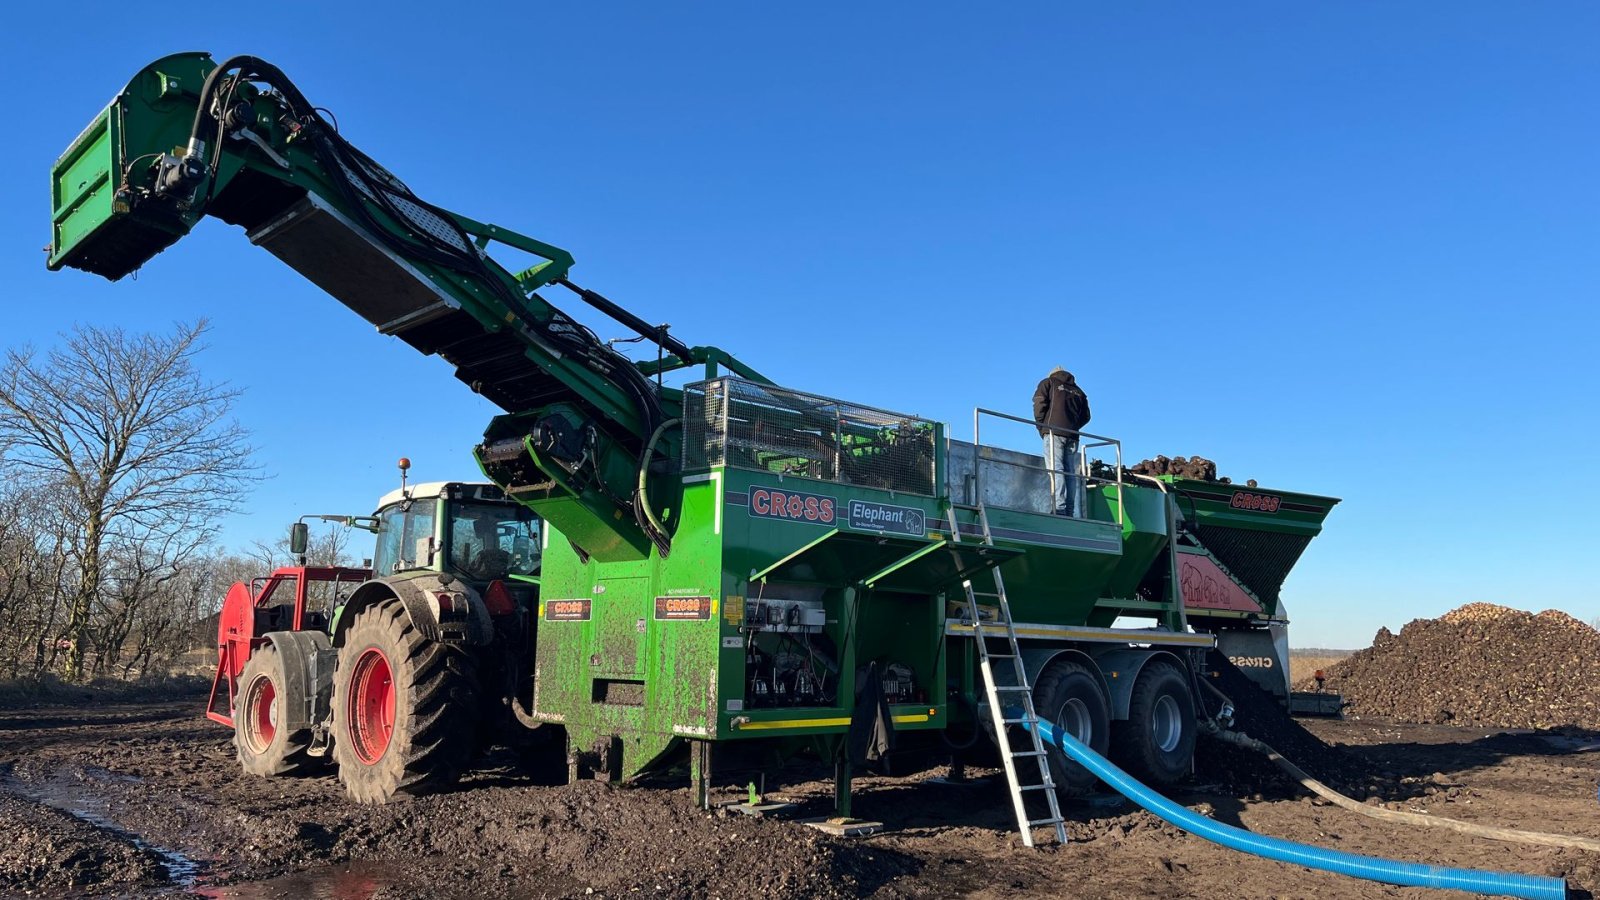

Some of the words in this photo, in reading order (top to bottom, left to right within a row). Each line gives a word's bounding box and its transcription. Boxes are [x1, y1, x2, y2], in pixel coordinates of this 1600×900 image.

[752, 489, 834, 523] CROSS
[1232, 492, 1279, 511] CROSS
[852, 503, 904, 523] Elephant
[554, 601, 583, 613] CROSS
[666, 599, 700, 611] CROSS
